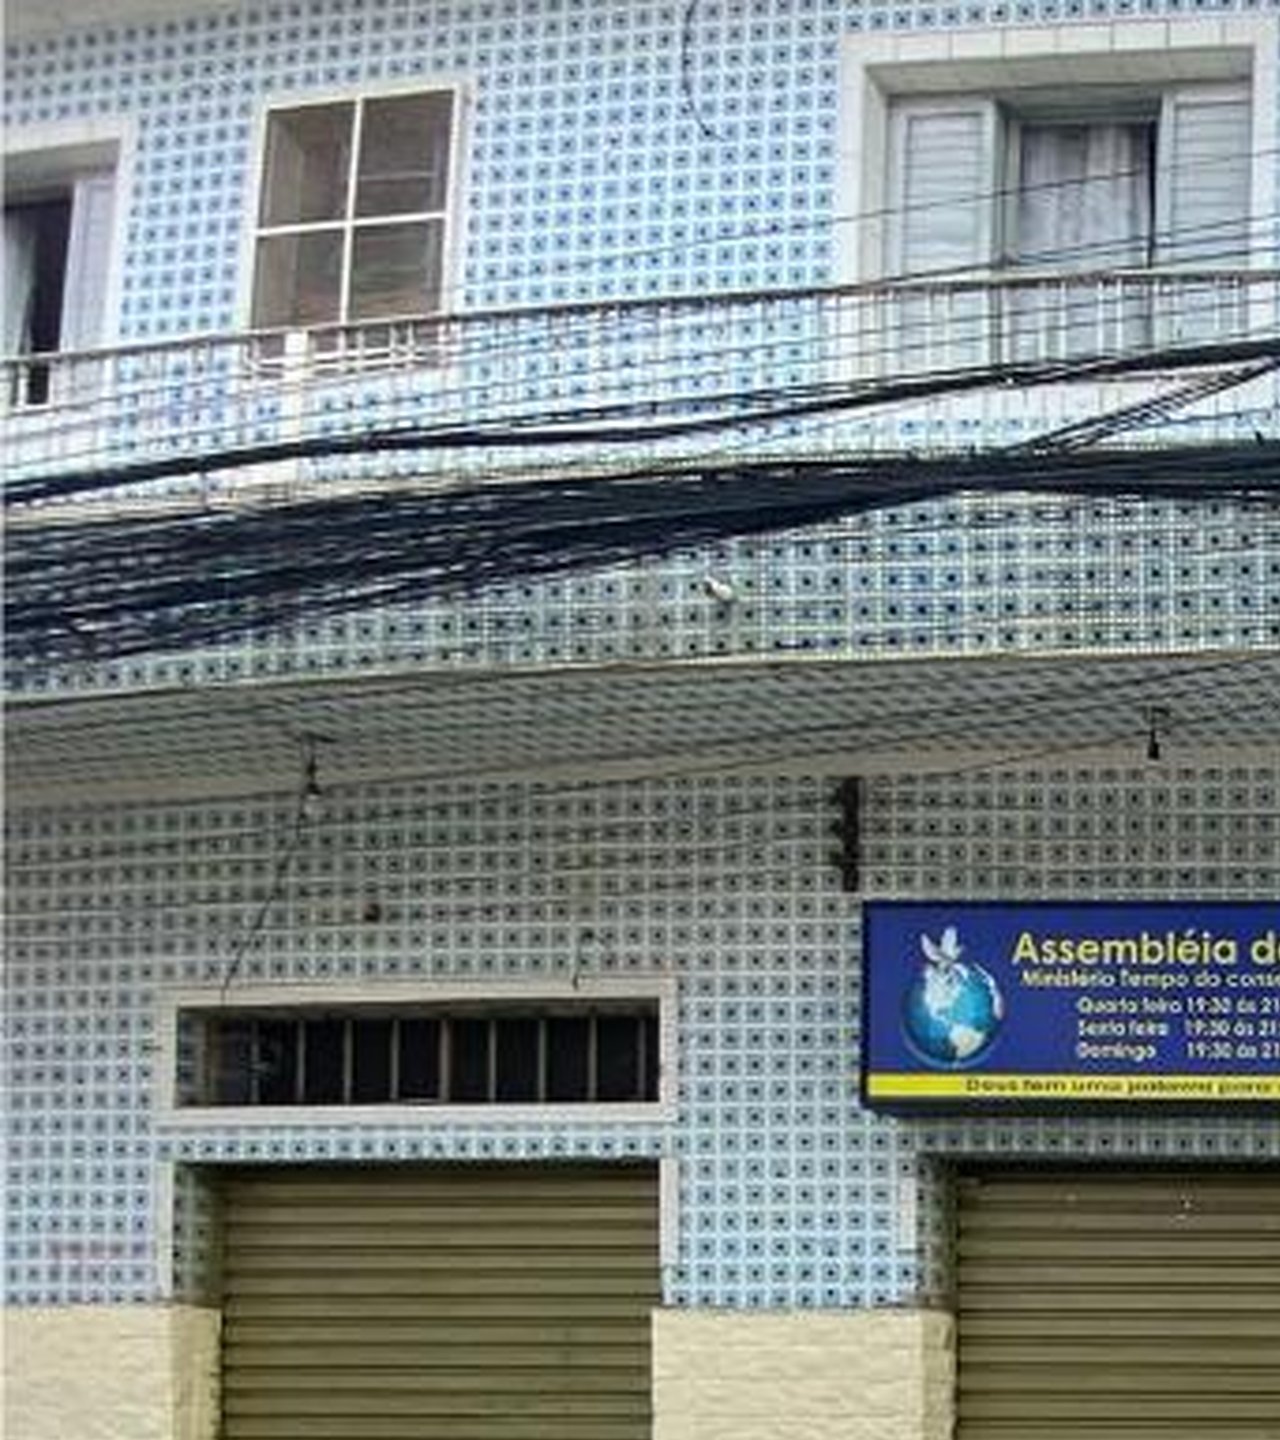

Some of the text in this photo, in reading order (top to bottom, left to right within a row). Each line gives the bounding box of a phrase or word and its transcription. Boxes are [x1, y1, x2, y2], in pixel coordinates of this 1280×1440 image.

[1011, 929, 1237, 965] Assembléia
[1119, 969, 1189, 990] Tempo
[1194, 969, 1221, 988] do
[1186, 1019, 1230, 1037] 19:30
[1077, 1042, 1156, 1061] Domingo
[1188, 1042, 1231, 1059] 19:30
